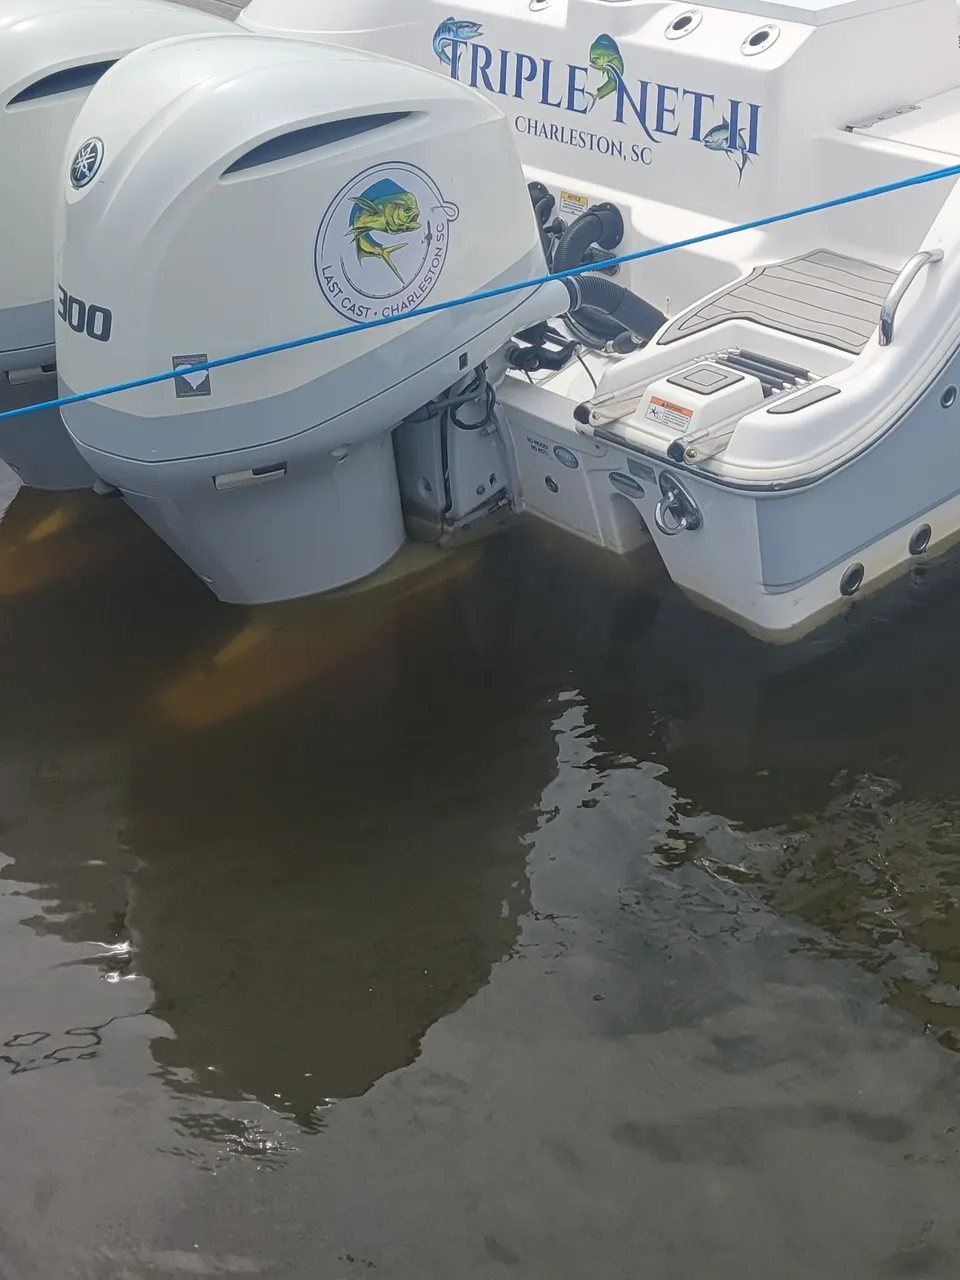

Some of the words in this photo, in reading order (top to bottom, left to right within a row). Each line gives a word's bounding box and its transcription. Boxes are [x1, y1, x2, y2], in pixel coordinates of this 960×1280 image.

[438, 36, 589, 115] TRIPLE
[604, 63, 715, 143] NET
[728, 98, 763, 156] II
[515, 115, 627, 162] CHARLESTON,
[630, 144, 653, 165] SC
[322, 264, 344, 299] LAST
[341, 296, 371, 319] CAST
[381, 247, 443, 318] CHARLESTON
[436, 222, 445, 243] SC
[58, 283, 112, 342] 300
